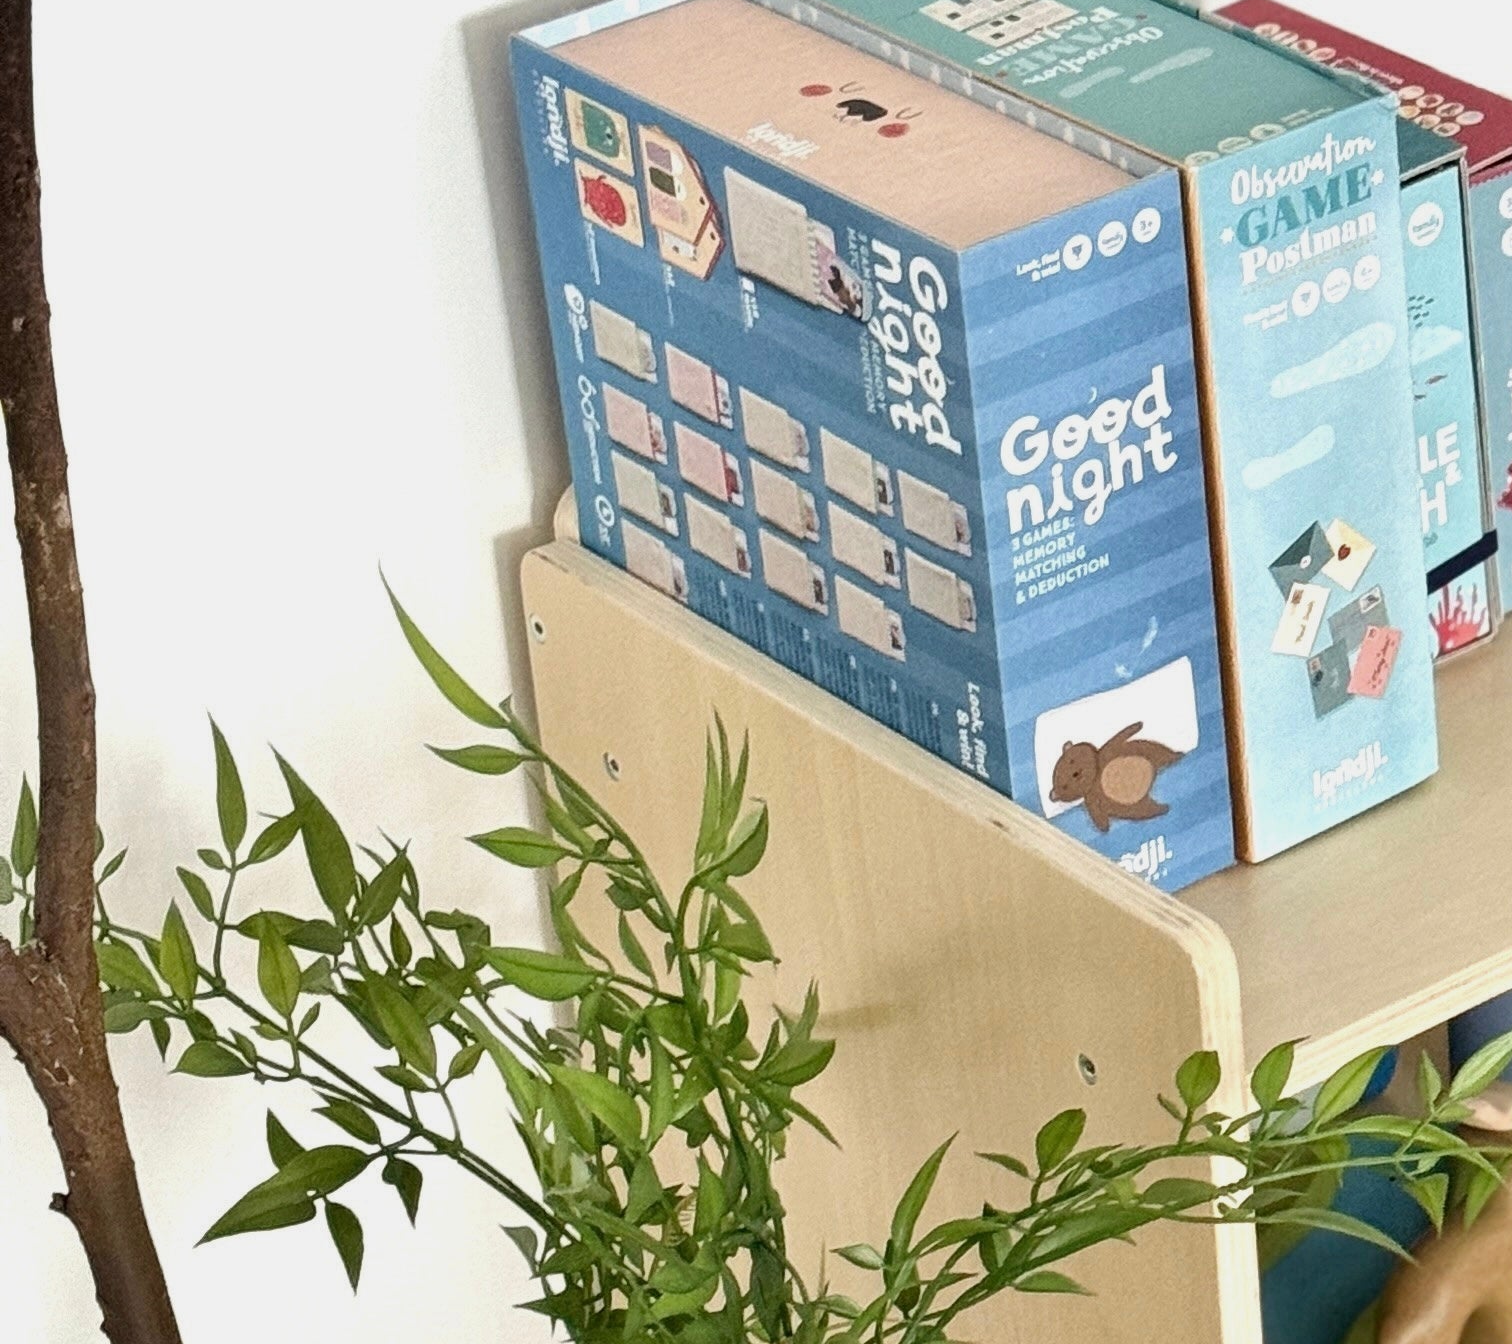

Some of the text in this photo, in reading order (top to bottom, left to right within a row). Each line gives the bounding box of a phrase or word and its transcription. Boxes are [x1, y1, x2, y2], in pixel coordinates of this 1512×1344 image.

[1231, 132, 1376, 205] Observation
[1236, 163, 1372, 247] GAME
[1240, 211, 1376, 287] Postman
[860, 330, 877, 414] EDUCTION
[868, 239, 924, 434] night
[909, 256, 962, 456] Good
[1000, 364, 1172, 476] Good
[1418, 422, 1461, 474] LE
[1007, 422, 1178, 534] night
[1446, 461, 1463, 487] &
[1013, 532, 1076, 569] MEMORY
[1015, 545, 1086, 587] MATCHING
[1023, 516, 1075, 546] GAMES:
[1016, 553, 1110, 605] & DEDUCTION
[1119, 835, 1173, 877] ndji.
